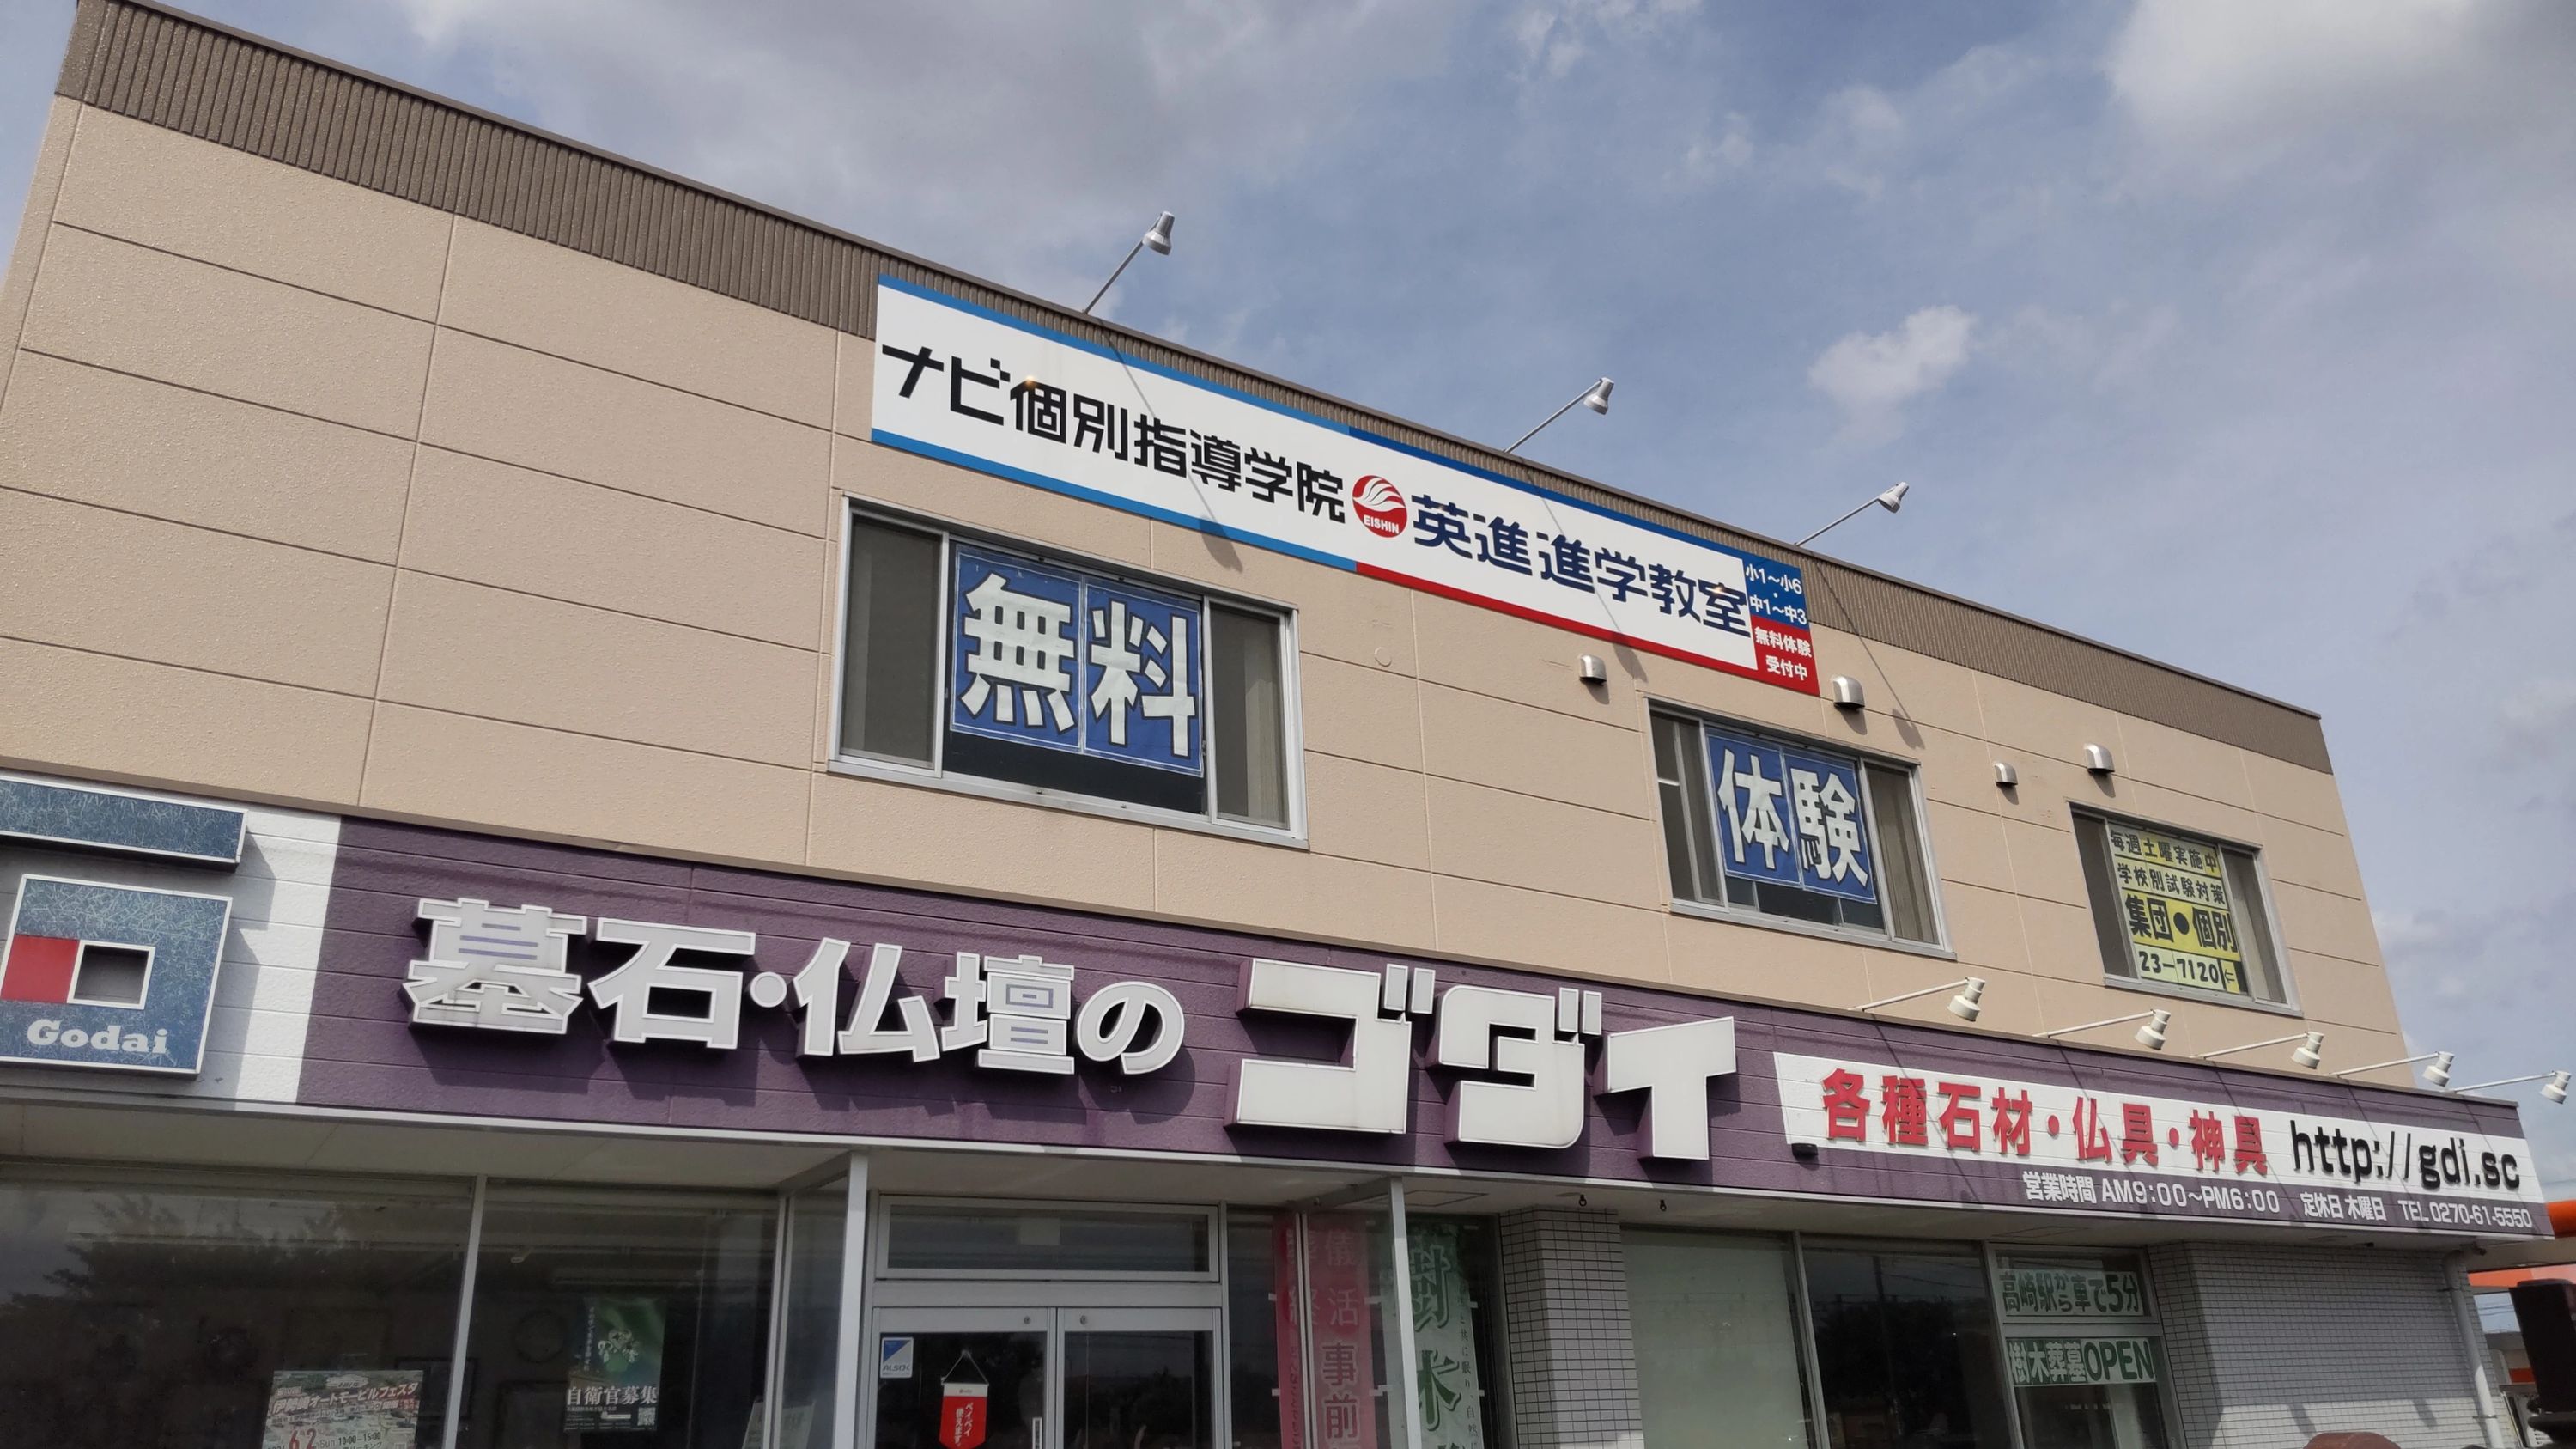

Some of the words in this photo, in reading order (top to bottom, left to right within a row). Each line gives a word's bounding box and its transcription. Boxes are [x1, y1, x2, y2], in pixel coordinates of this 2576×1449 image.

[882, 346, 1346, 525] ナビ個別指導学院
[1364, 514, 1400, 534] EISHIN
[1411, 494, 1752, 638] 英進進学教室
[960, 572, 1196, 758] 無料
[1754, 626, 1813, 658] 無料体験
[1765, 654, 1808, 681] 受付中
[1717, 748, 1868, 887] 体験
[2110, 829, 2218, 873] 毎週土曜実施中
[2117, 863, 2226, 904] 学校別試験対策
[2138, 951, 2220, 983] 23-7120
[27, 1020, 168, 1056] Godai
[402, 897, 1186, 1075] 墓石・仏壇の
[1231, 958, 1736, 1161] ゴダイ
[1821, 1068, 2269, 1176] 各種石材・仏具・神具
[2289, 1119, 2521, 1190] http://gdi.sc
[2022, 1171, 2097, 1203] 営業時間
[2302, 1192, 2343, 1220] 定休日
[2347, 1195, 2387, 1221] 木曜日
[2397, 1200, 2430, 1222] TEL
[2431, 1202, 2533, 1228] 0270-61-5550
[566, 1385, 658, 1406] 自衛官募集
[963, 1402, 974, 1437] ペイペイ
[1323, 1342, 1359, 1449] 事前
